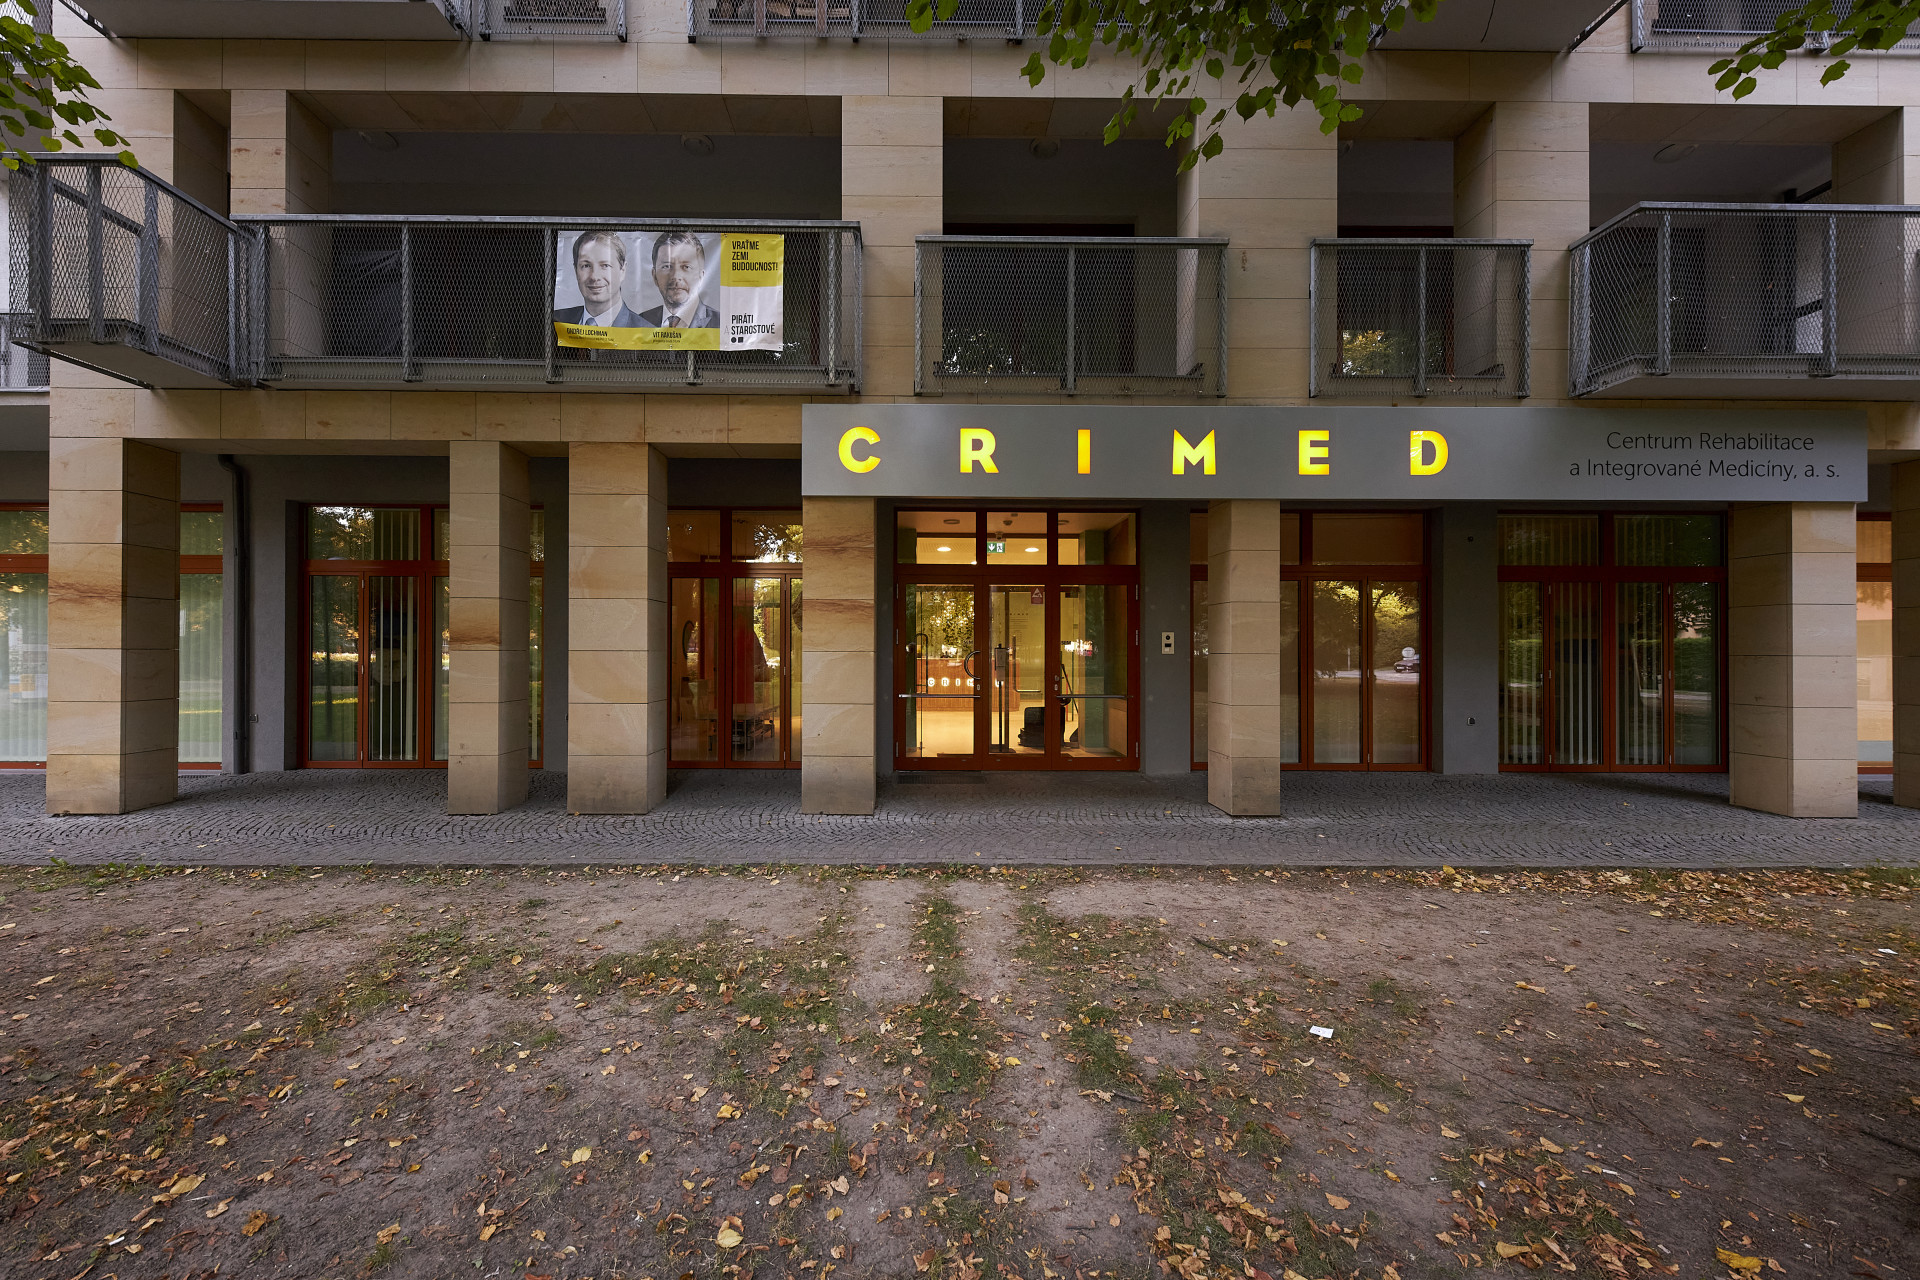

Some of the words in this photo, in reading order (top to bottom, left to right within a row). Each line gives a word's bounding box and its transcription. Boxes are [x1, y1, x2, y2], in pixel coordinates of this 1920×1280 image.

[731, 239, 760, 250] VRAŤME
[731, 251, 749, 261] ZEMI
[731, 261, 778, 271] BUDOUCNOST!
[731, 313, 754, 324] PIRÁTI
[731, 323, 775, 335] STAROSTOVÉ
[1606, 432, 1692, 450] Centrum
[1700, 432, 1815, 451] Rehabilitace
[838, 426, 1449, 476] CRIMED
[1570, 462, 1580, 476] a
[1588, 459, 1702, 481] Integrované
[1708, 459, 1797, 481] Medicíny,
[1804, 464, 1819, 478] a.
[1826, 464, 1840, 478] s.
